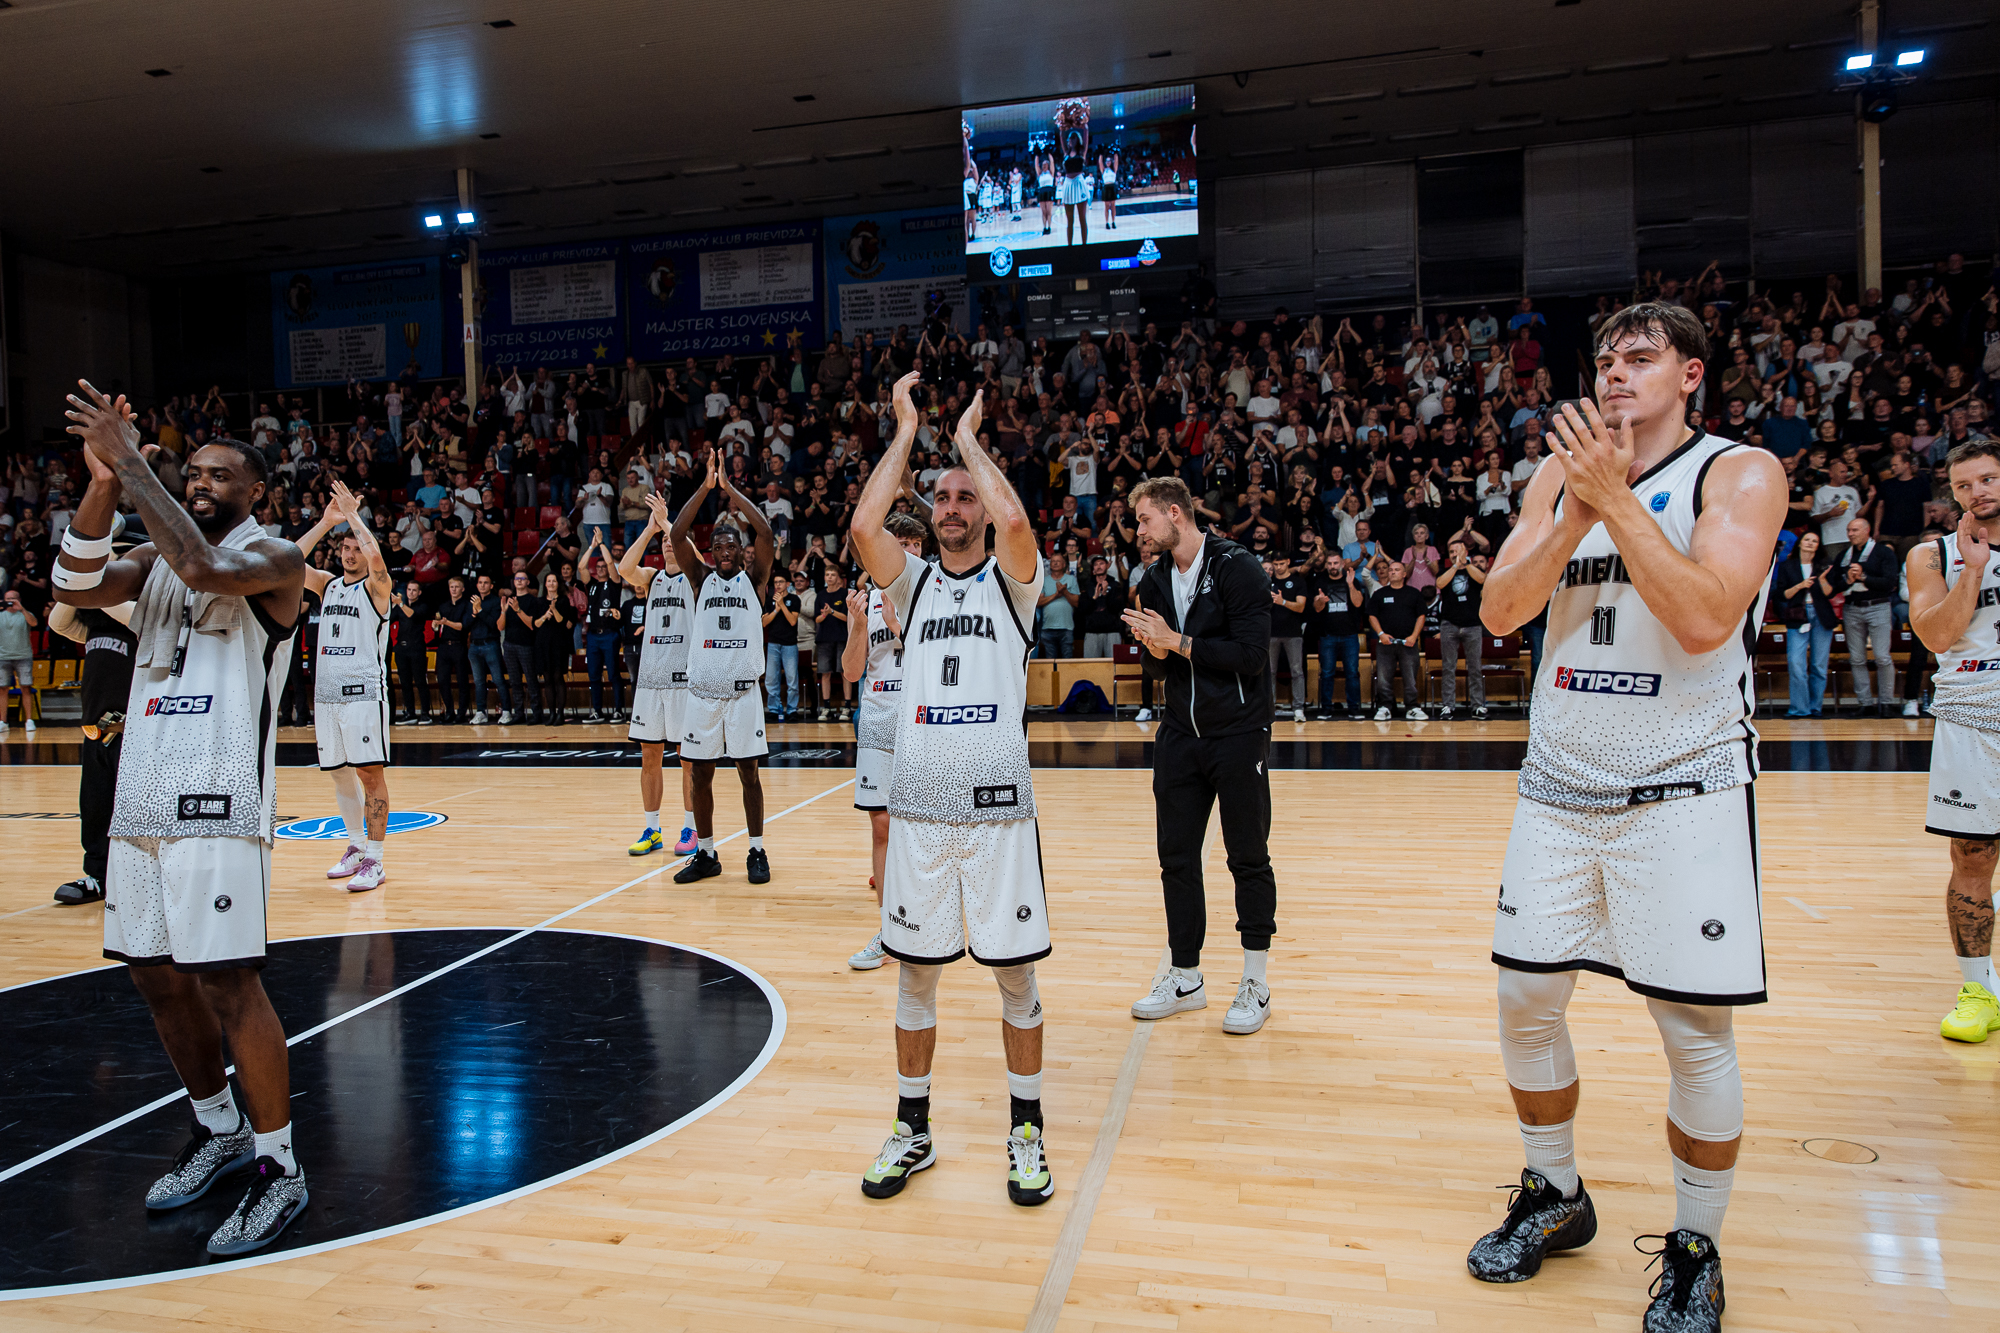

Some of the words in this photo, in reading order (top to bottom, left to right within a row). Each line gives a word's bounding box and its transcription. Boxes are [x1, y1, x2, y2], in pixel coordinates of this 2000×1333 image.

[631, 233, 708, 253] VOLEJBALOVÝ
[712, 233, 741, 246] KLUB
[745, 228, 805, 243] PRIEVIDZA
[522, 252, 549, 264] KLUB
[552, 246, 609, 260] PRIEVIDZA
[1027, 294, 1053, 302] DOMÁCI
[1109, 288, 1136, 296] HOSTIA
[645, 317, 715, 335] MAJSTER
[720, 310, 812, 330] SLOVENSKA
[466, 327, 473, 340] A
[529, 326, 614, 344] SLOVENSKA
[662, 334, 751, 353] 2018/2019
[495, 348, 579, 365] 2017/2018
[704, 596, 749, 611] PRIEVIDZA
[662, 614, 671, 628] 10
[718, 615, 731, 630] 55
[1590, 606, 1616, 645] 11
[656, 636, 682, 644] TIPOS
[714, 640, 745, 648] TIPOS
[940, 654, 960, 686] 17
[886, 681, 902, 690] TIP
[1573, 671, 1655, 693] TIPOS
[929, 706, 993, 723] TIPOS
[1000, 789, 1014, 798] ARE
[207, 800, 225, 809] ARE
[1933, 795, 1942, 803] ST
[1942, 797, 1977, 810] NICOLAUS
[892, 914, 920, 931] NICOLAUS
